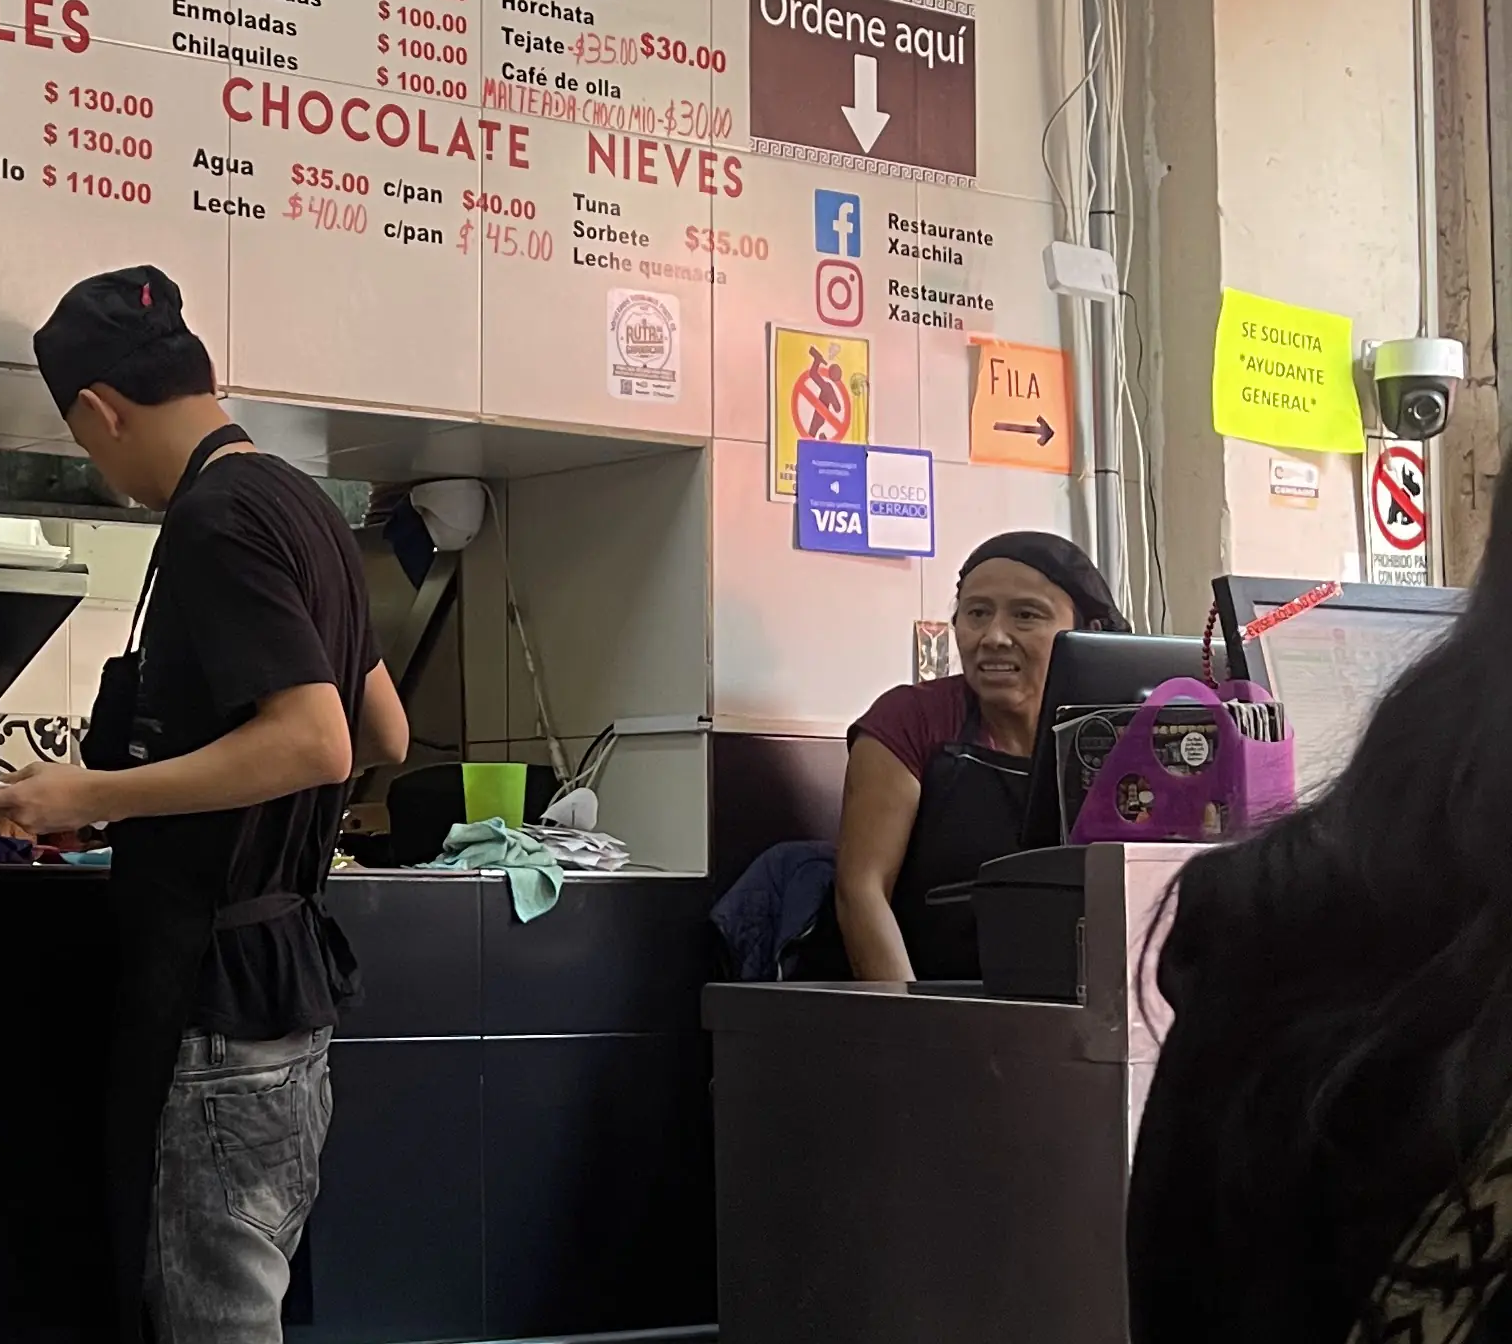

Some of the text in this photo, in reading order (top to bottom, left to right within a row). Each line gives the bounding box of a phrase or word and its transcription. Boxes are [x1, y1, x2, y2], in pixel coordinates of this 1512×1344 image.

[172, 31, 299, 71] Chilaquiles
[501, 26, 726, 73] Tejate $30.00
[895, 22, 967, 69] aquí
[502, 62, 621, 99] Café de olla
[222, 76, 530, 170] CHOCOLATE
[588, 130, 743, 198] NIEVES
[192, 148, 536, 220] Agua $35.00 c/pan $40.00
[193, 190, 267, 220] Leche
[573, 192, 621, 217] Tuna
[384, 220, 443, 245] c/pan
[573, 220, 769, 260] Sorbete $35.00
[888, 212, 993, 247] Restaurante
[573, 247, 727, 285] Leche quemada
[888, 237, 963, 266] Xaachila
[888, 279, 994, 311] Restaurante
[888, 303, 964, 331] Xaachila
[1242, 321, 1322, 353] SE SOLICITA
[990, 358, 1040, 399] FILA
[870, 483, 927, 502] CLOSED
[871, 502, 927, 518] CERRADO
[810, 509, 862, 534] VISA
